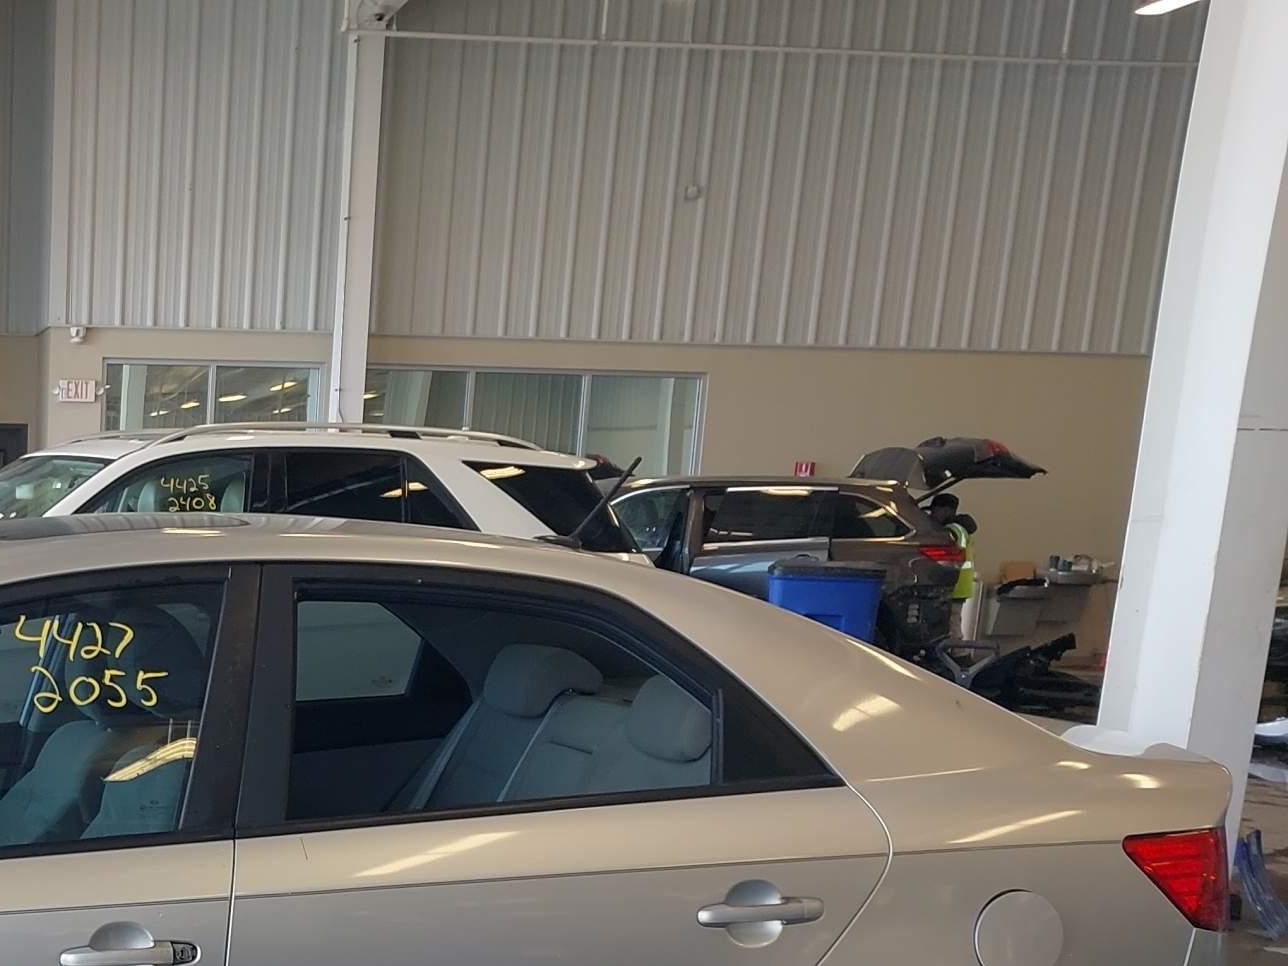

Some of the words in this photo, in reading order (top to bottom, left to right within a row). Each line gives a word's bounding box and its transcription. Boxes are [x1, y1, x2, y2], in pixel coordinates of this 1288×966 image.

[67, 381, 89, 399] EXIT
[160, 474, 210, 494] 4425
[168, 493, 217, 512] 2408
[15, 614, 134, 661] 4427
[31, 665, 169, 713] 2055
